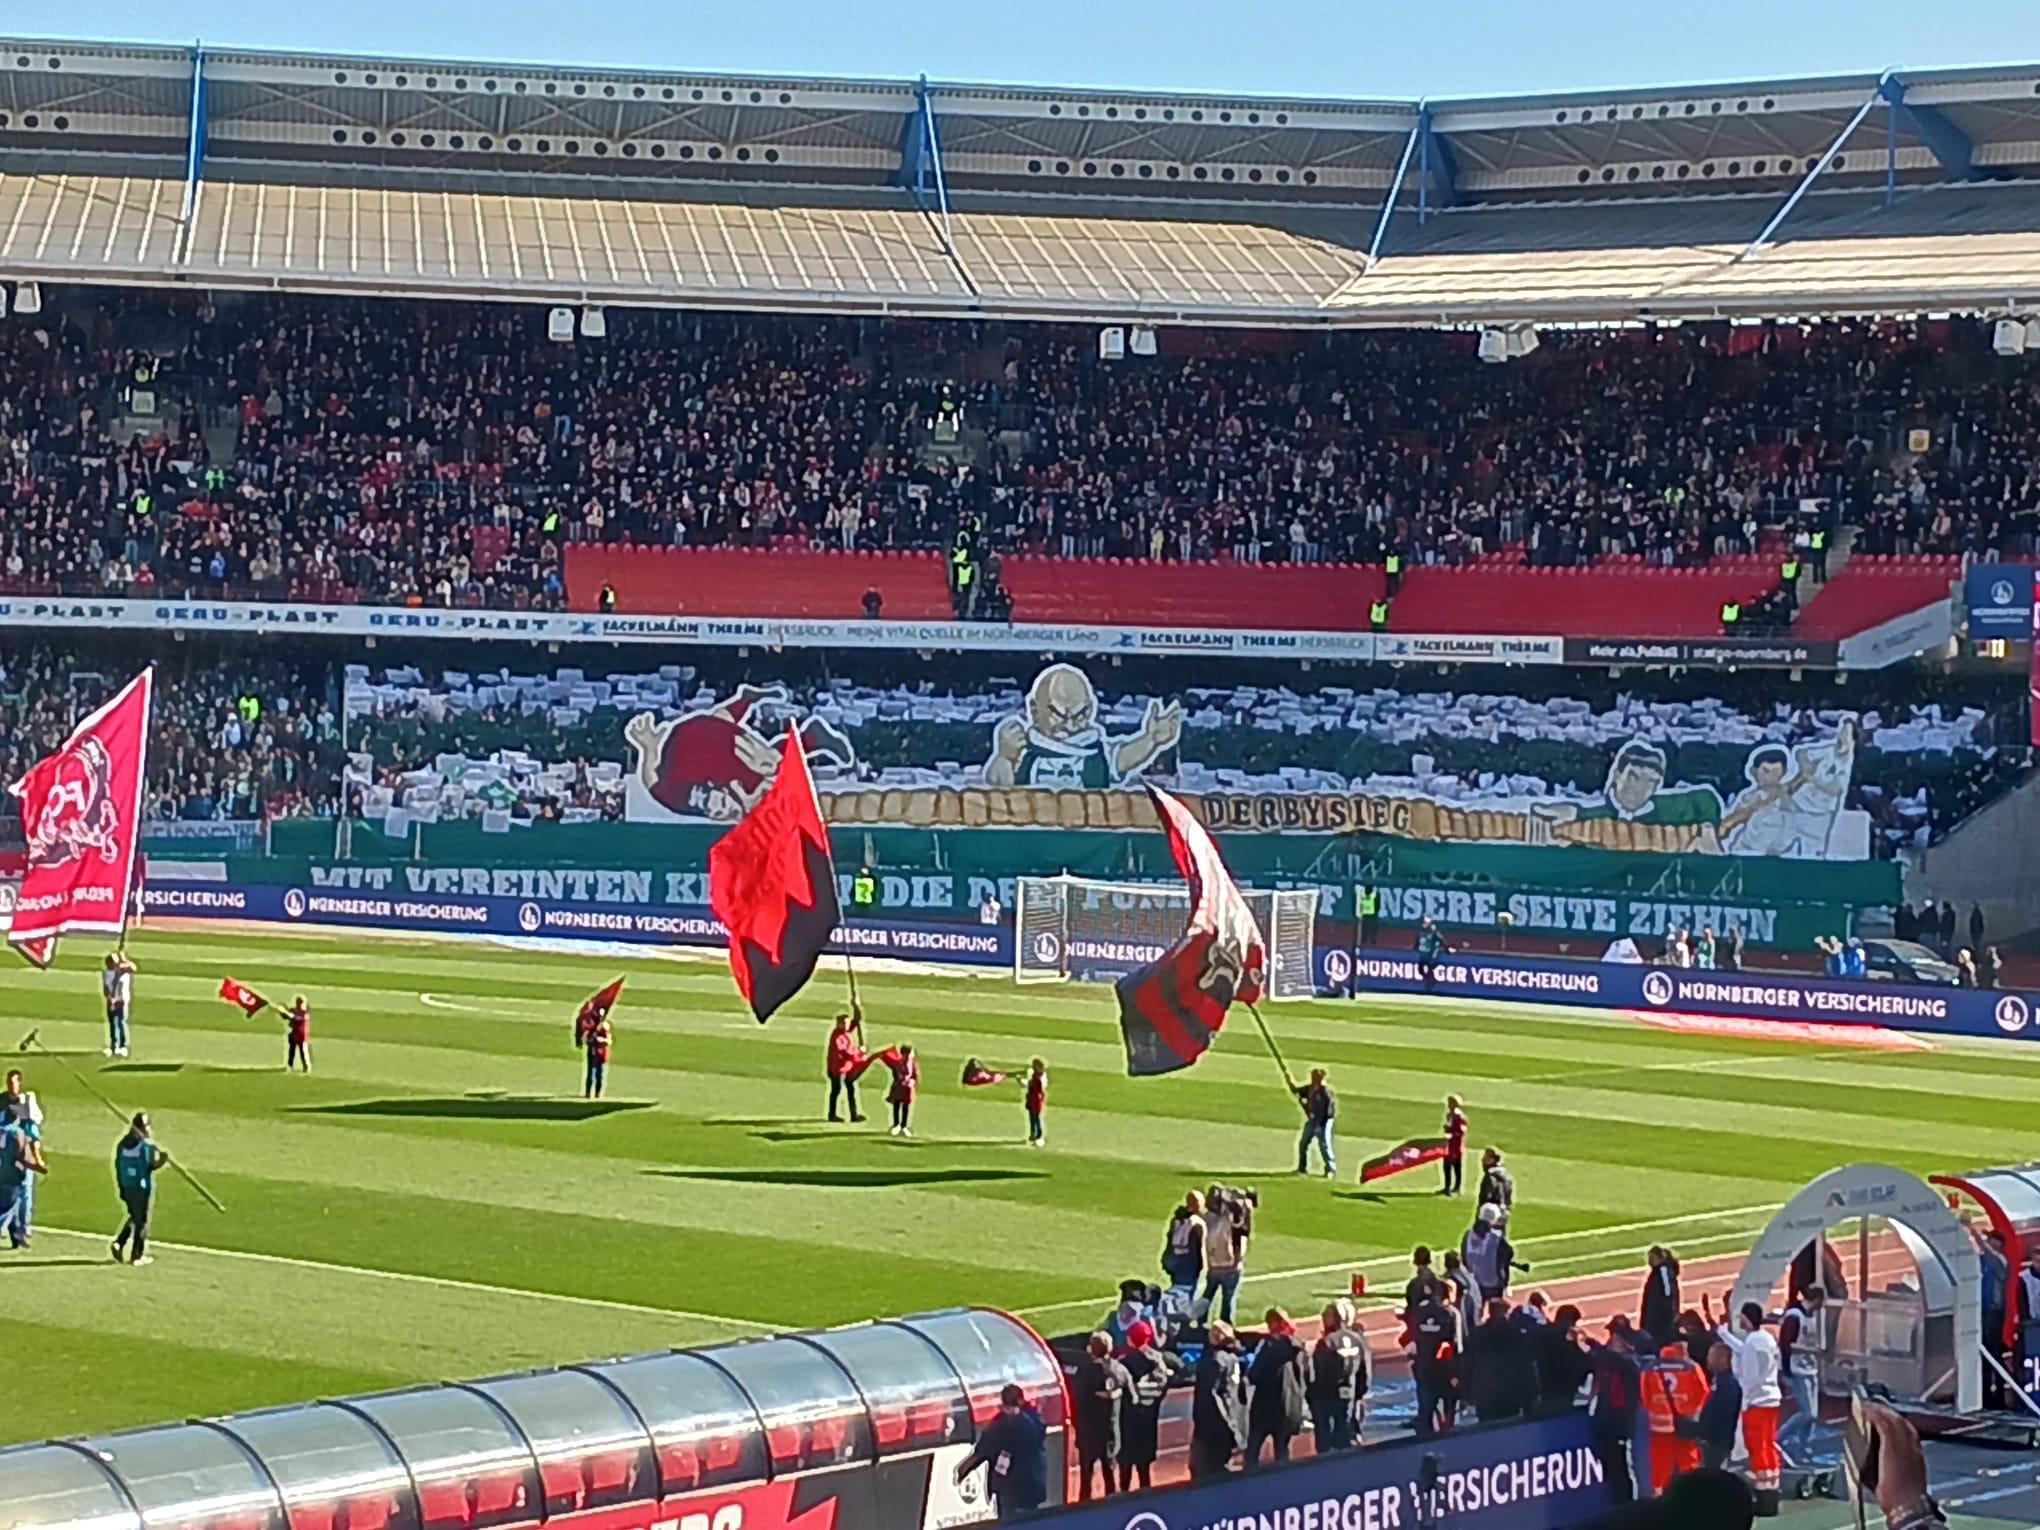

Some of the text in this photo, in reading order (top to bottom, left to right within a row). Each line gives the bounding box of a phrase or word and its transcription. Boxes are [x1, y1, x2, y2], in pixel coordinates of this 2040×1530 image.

[707, 623, 763, 635] THERME
[1141, 633, 1233, 645] FACKELMANN
[1242, 636, 1297, 647] THERME
[1205, 797, 1410, 832] DERBYSIEG
[308, 896, 488, 923] NÜRNBERGER VERSICHERUNG
[405, 868, 653, 904] VEREINTEN
[882, 875, 953, 907] DIE
[1508, 893, 1617, 932] SEITE
[1629, 901, 1777, 942] ZIEHEN
[545, 910, 632, 932] NÜRNBERGER
[892, 930, 998, 954] VERSICHERUNG
[1473, 967, 1599, 993] VERSICHERUNG
[1679, 981, 1947, 1018] NÜRNBERGER VERSICHERUNG
